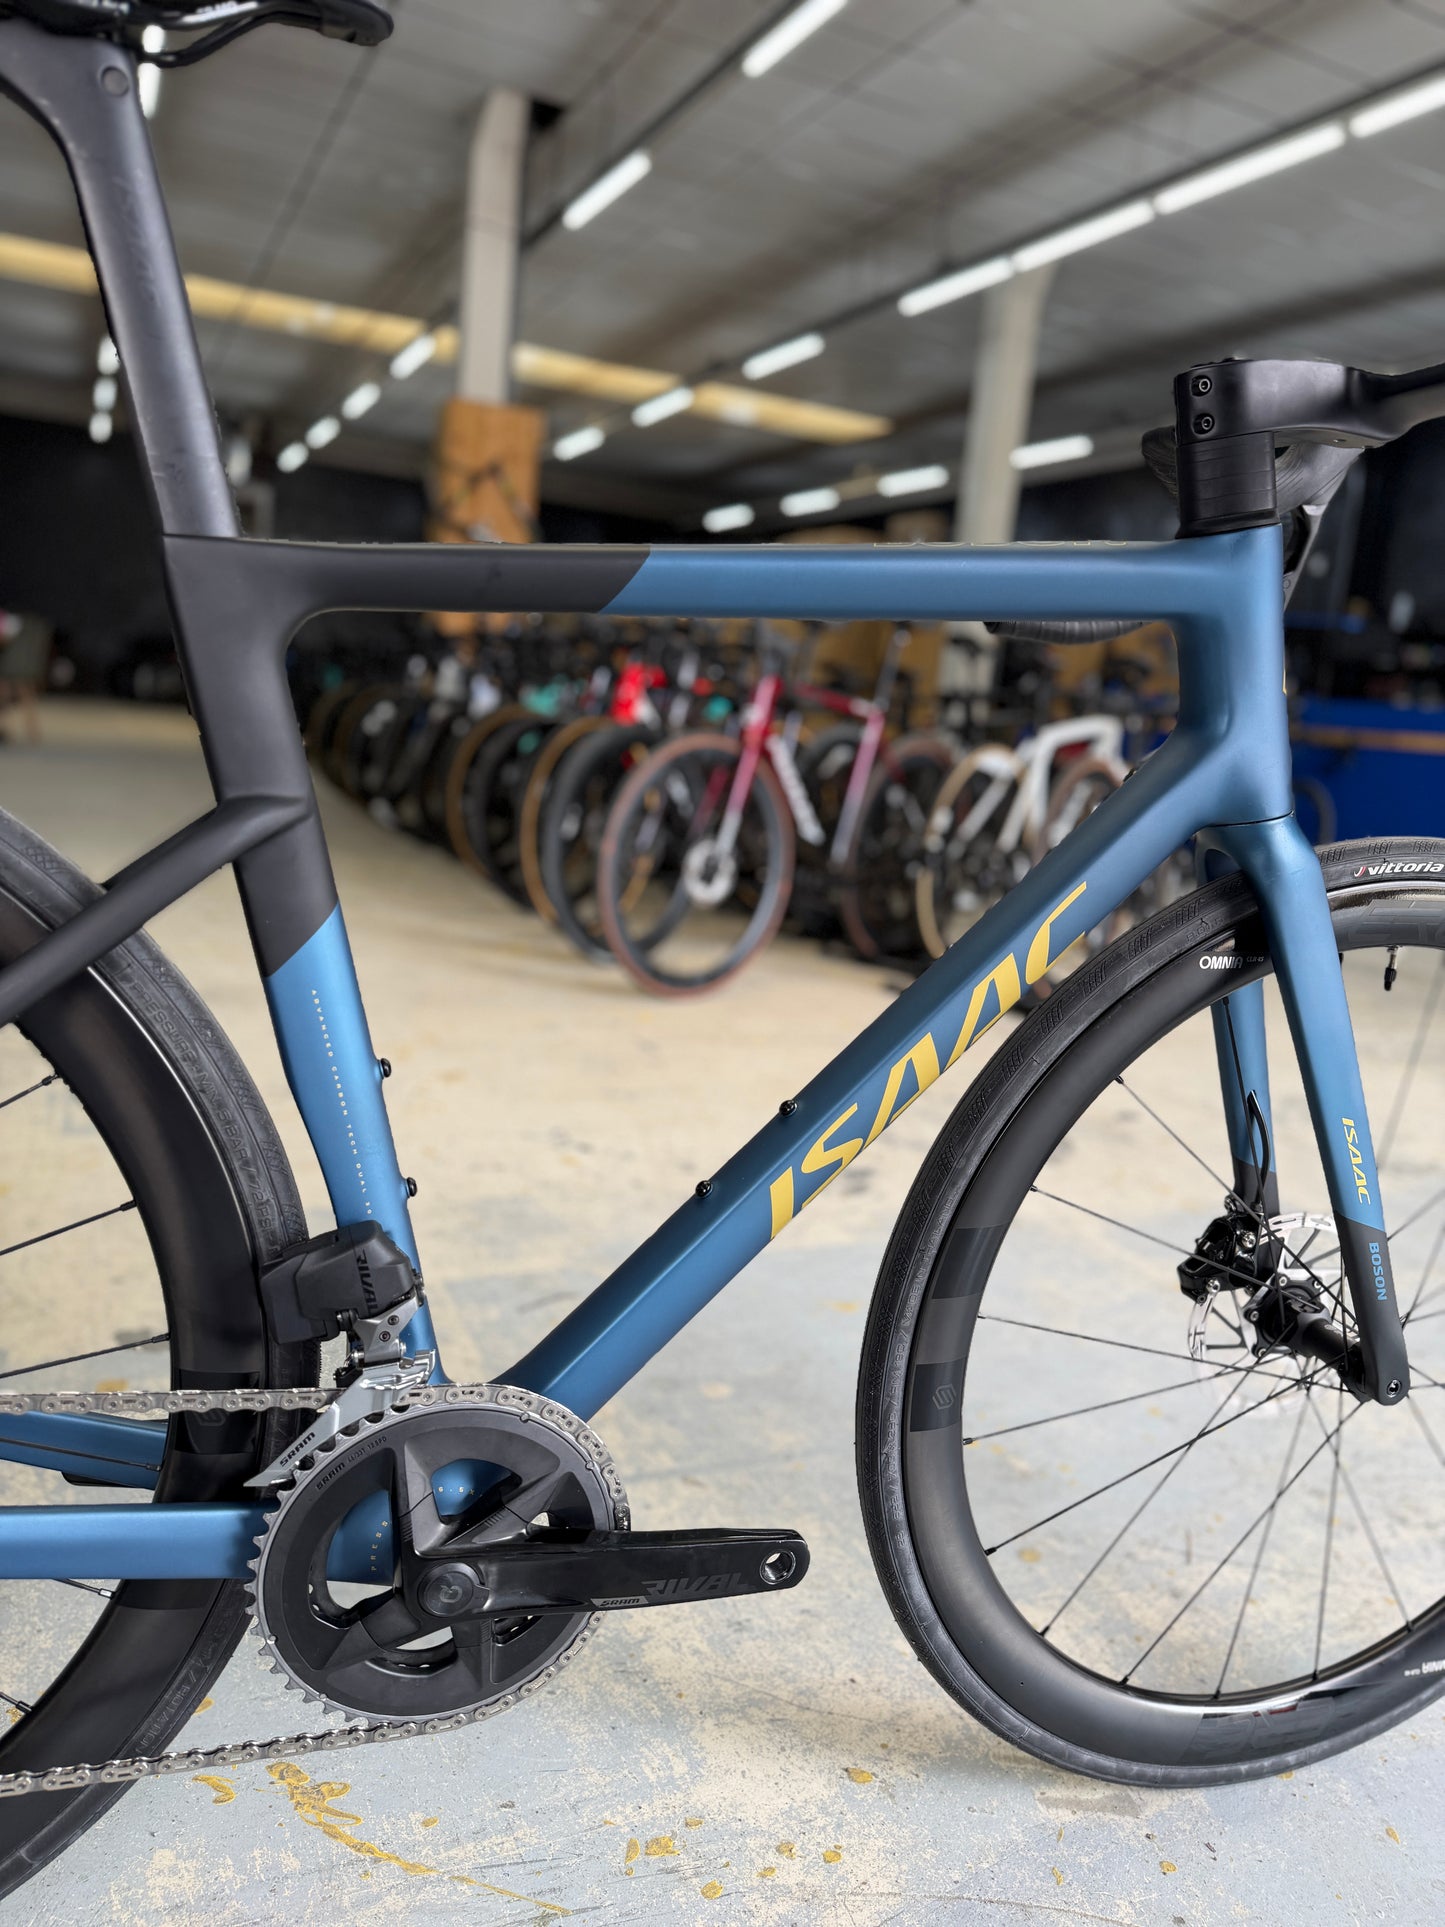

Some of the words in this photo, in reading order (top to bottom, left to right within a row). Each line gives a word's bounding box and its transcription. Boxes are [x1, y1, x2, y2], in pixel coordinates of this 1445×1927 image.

[1367, 861, 1444, 876] vittoria
[1199, 955, 1243, 970] OMNIA
[770, 881, 1087, 1239] ISAAC
[1341, 1117, 1371, 1205] ISAAC
[356, 1248, 379, 1312] RIVAL
[1368, 1242, 1388, 1301] BOSON
[279, 1431, 316, 1468] SRAM
[316, 1462, 346, 1490] SRAM
[641, 1573, 755, 1597] RIVAL
[600, 1598, 640, 1607] SRAM
